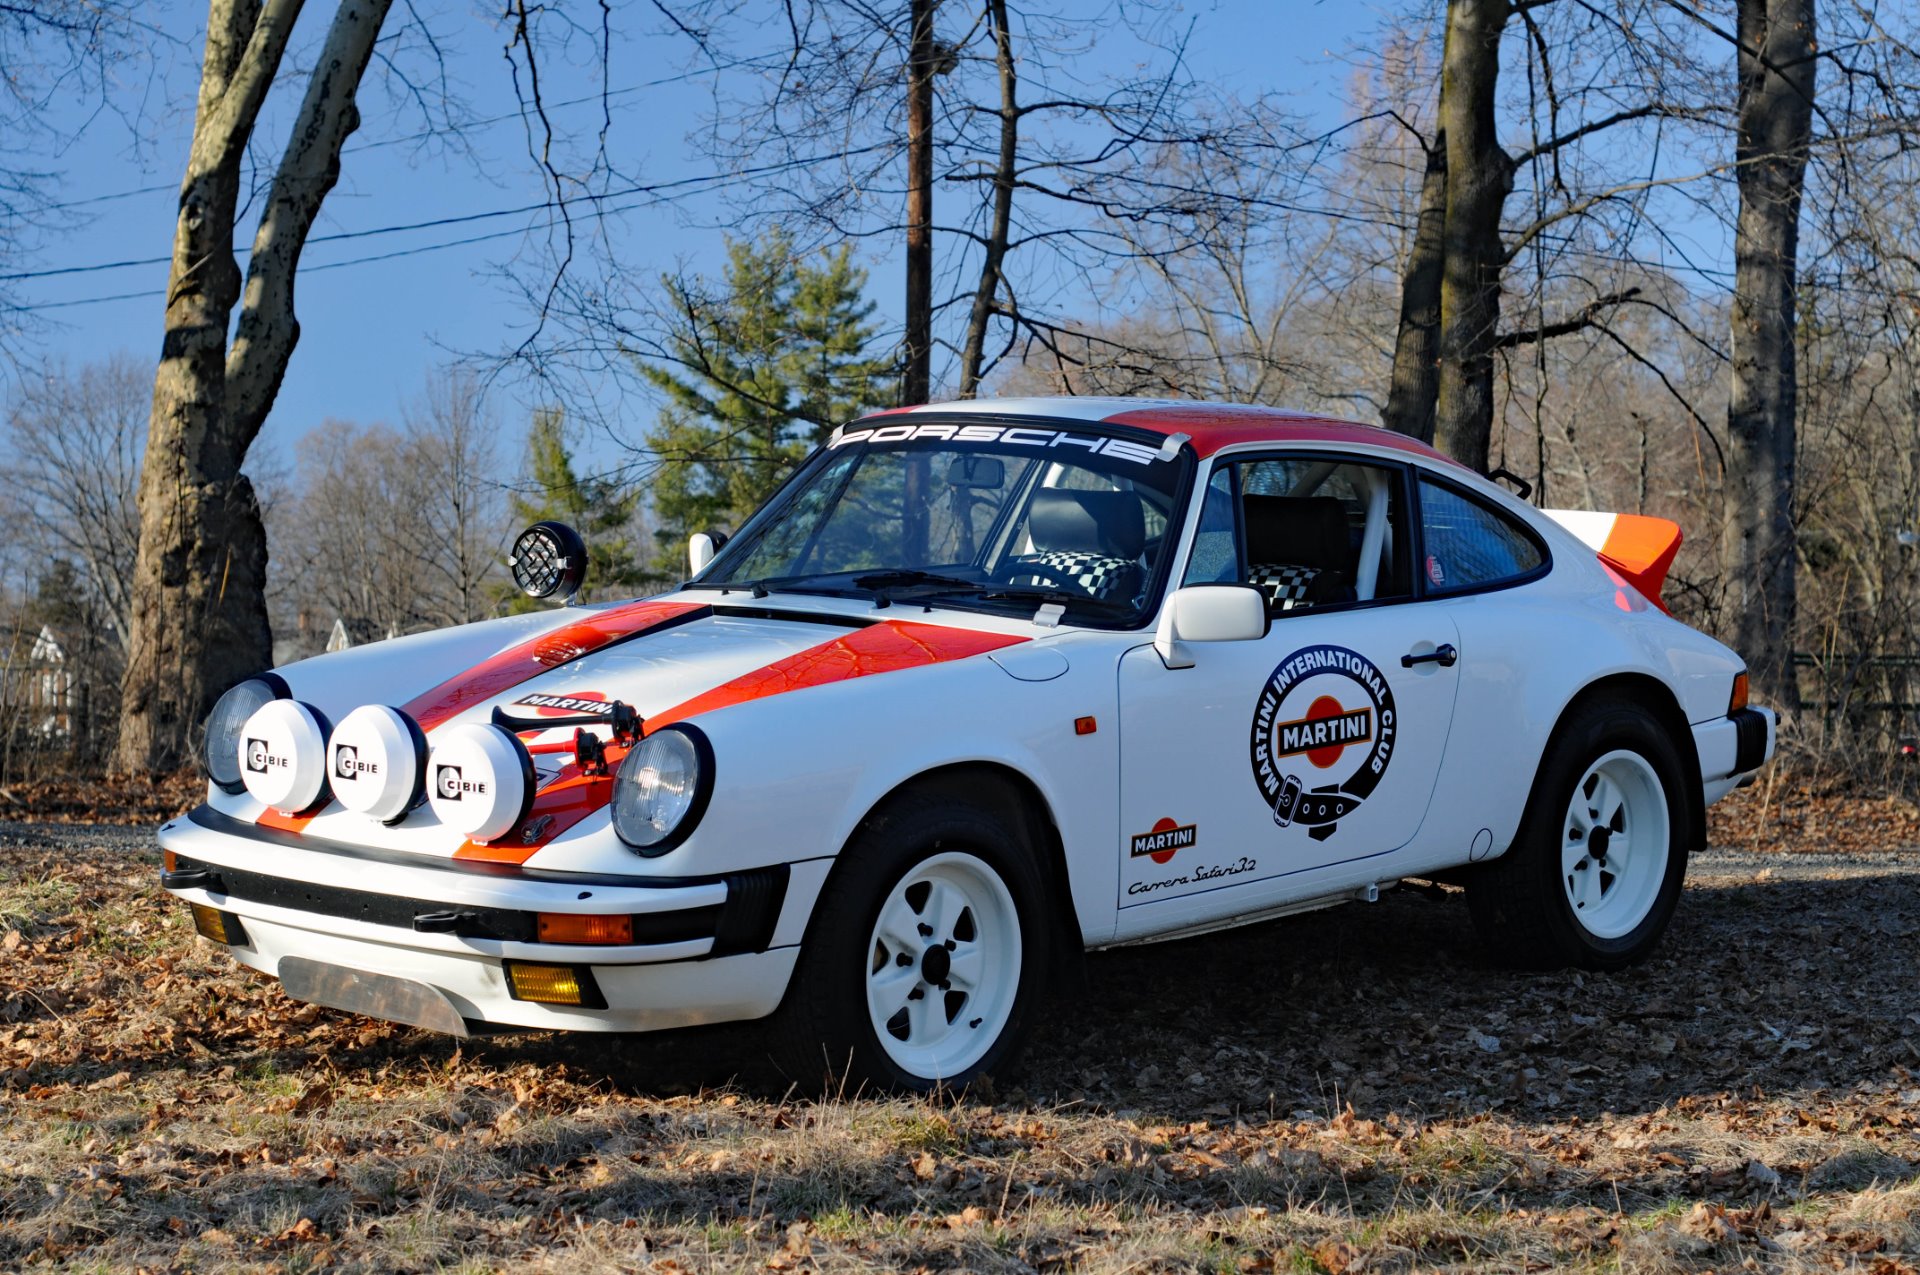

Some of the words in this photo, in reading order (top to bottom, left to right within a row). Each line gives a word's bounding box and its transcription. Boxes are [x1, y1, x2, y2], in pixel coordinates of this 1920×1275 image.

[830, 425, 1161, 466] PORSCHE
[521, 694, 613, 714] MARTIN
[1256, 691, 1280, 796] MARTINI
[1272, 650, 1387, 706] INTERNATIONAL
[1371, 709, 1393, 774] CLUB
[1283, 715, 1366, 750] MARTINI
[255, 753, 289, 768] CIBIE
[344, 760, 379, 774] CIBIE
[447, 780, 486, 794] CIBIE
[1135, 829, 1193, 853] MARTINI
[1128, 875, 1189, 895] Carrera
[1191, 865, 1238, 882] Safari
